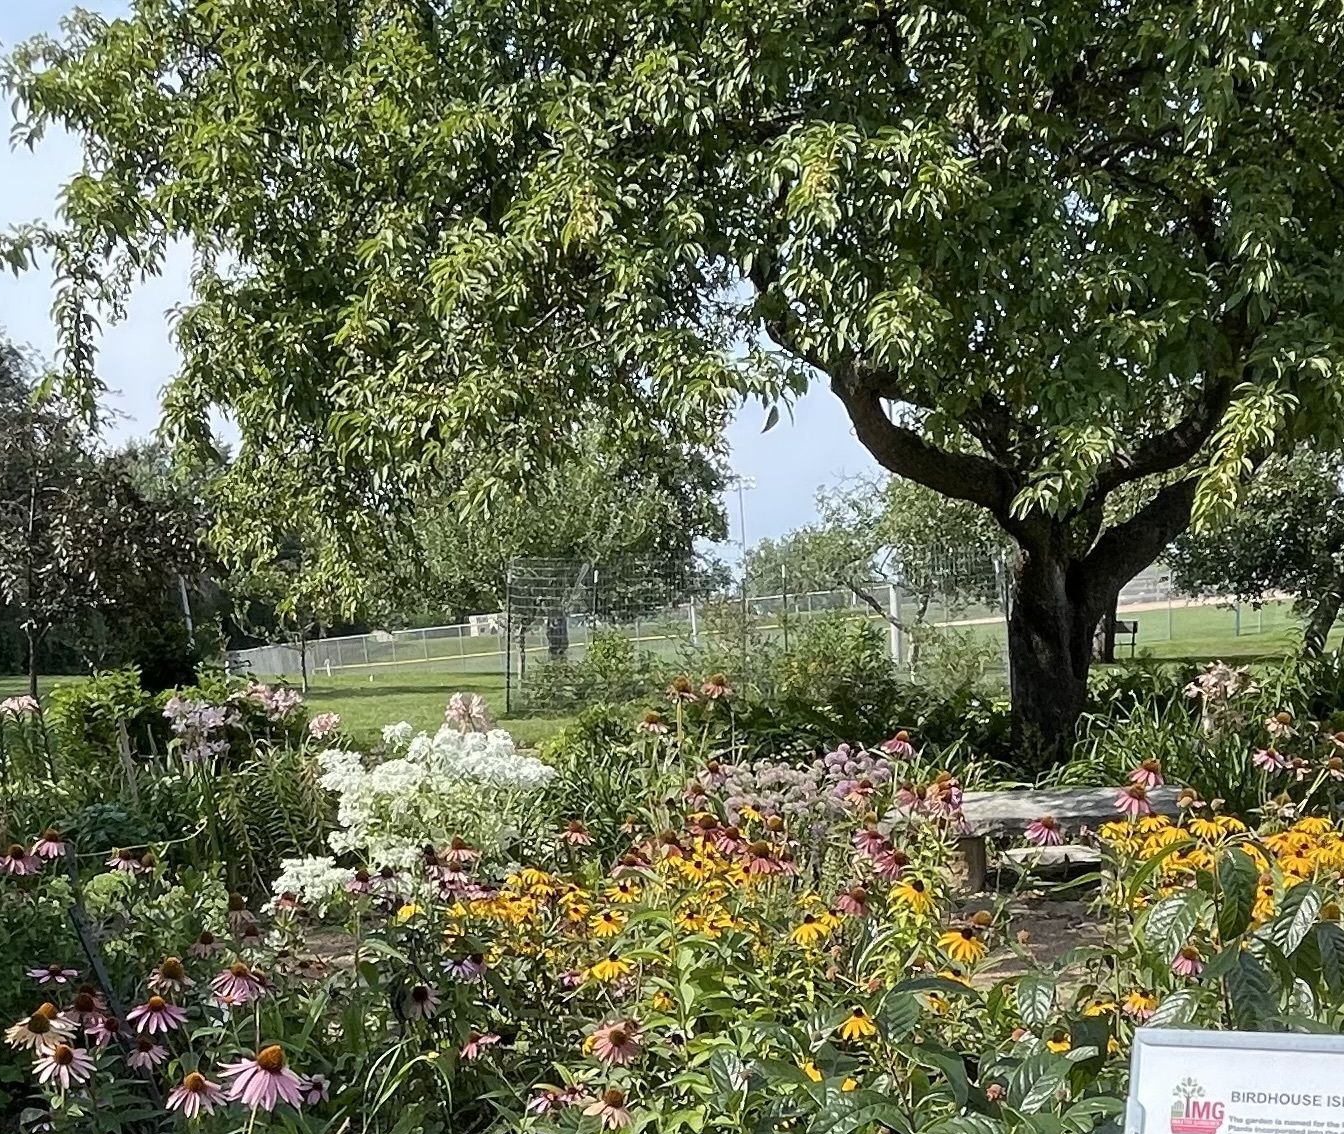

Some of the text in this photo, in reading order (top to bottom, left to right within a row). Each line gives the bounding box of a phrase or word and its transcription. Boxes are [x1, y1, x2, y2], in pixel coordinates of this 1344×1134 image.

[1230, 1090, 1322, 1106] BIRDHOUSE
[1228, 1115, 1243, 1123] The
[1244, 1117, 1273, 1125] garden
[1227, 1124, 1252, 1132] Plants
[1254, 1125, 1306, 1134] incorporated
